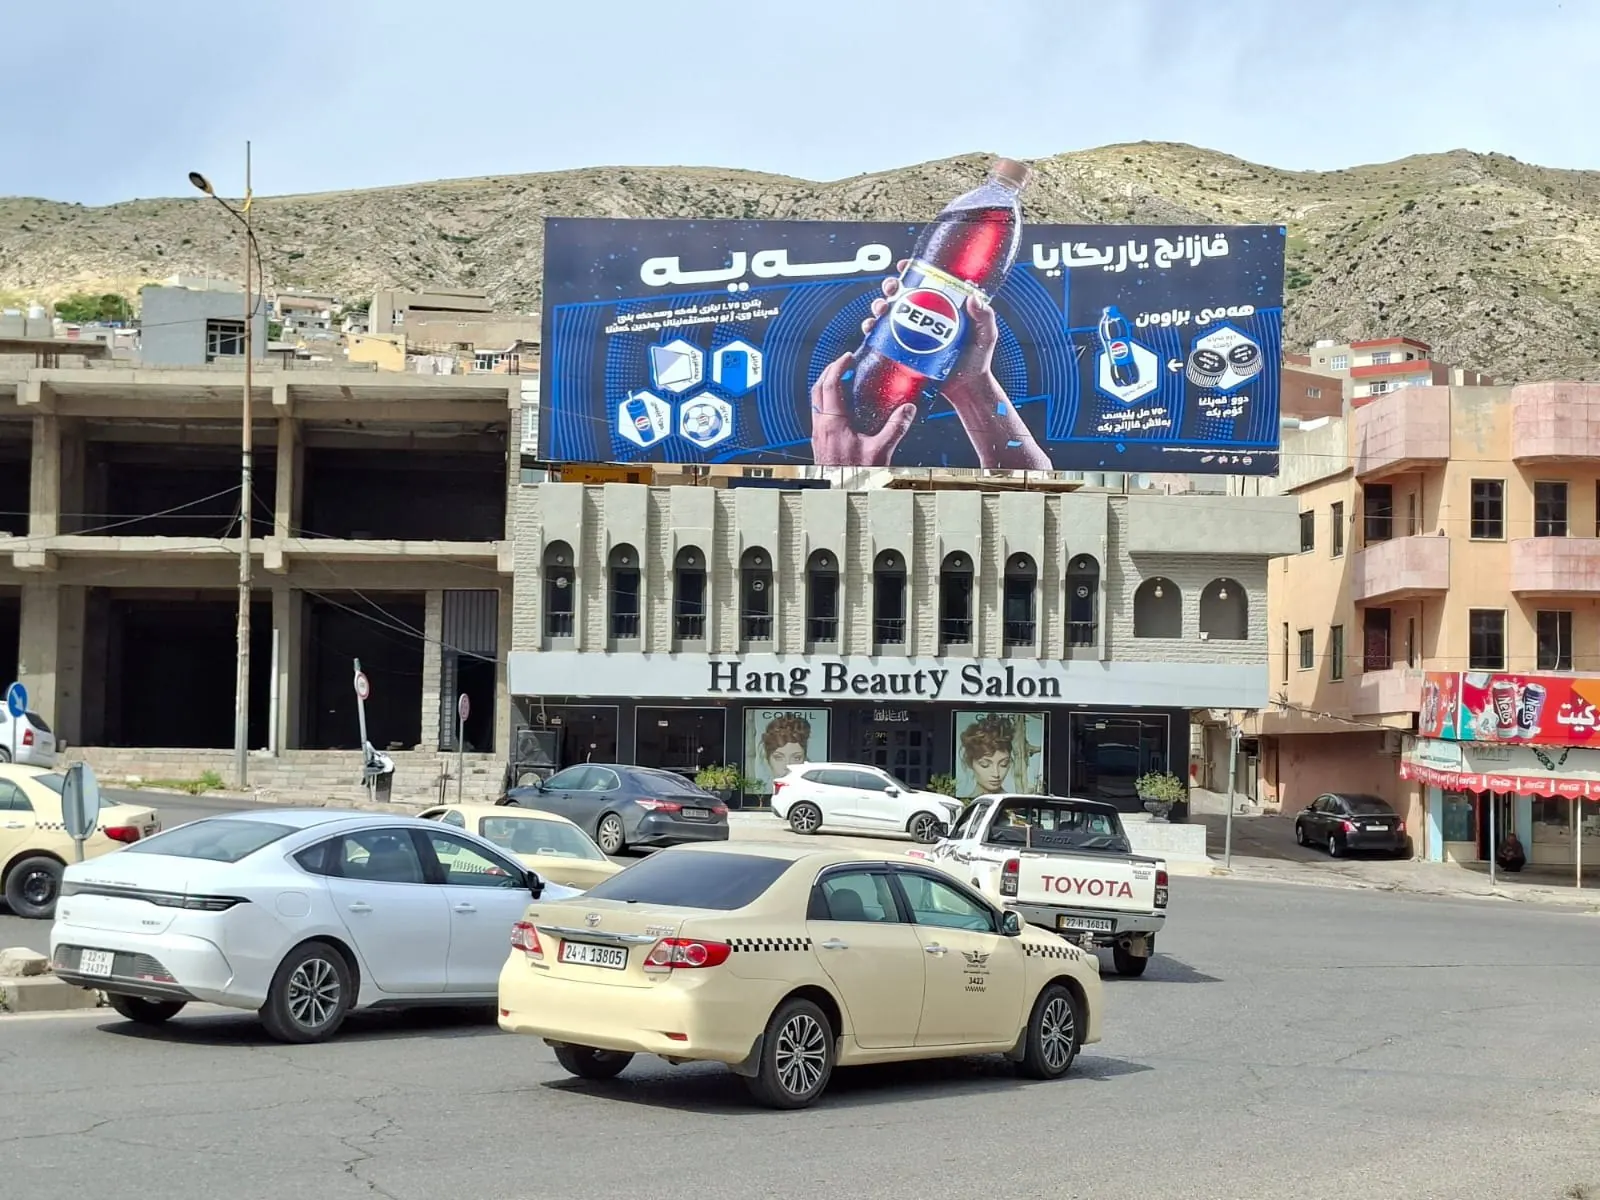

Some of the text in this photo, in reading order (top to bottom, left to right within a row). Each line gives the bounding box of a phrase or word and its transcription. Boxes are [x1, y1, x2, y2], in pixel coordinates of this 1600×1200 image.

[1154, 233, 1229, 268] قازانج
[896, 302, 953, 339] PEPSI
[707, 662, 1062, 699] Hang Beauty Salon
[762, 711, 816, 720] COTRIL
[1041, 875, 1133, 898] TOYOTA
[589, 946, 623, 965] 13805
